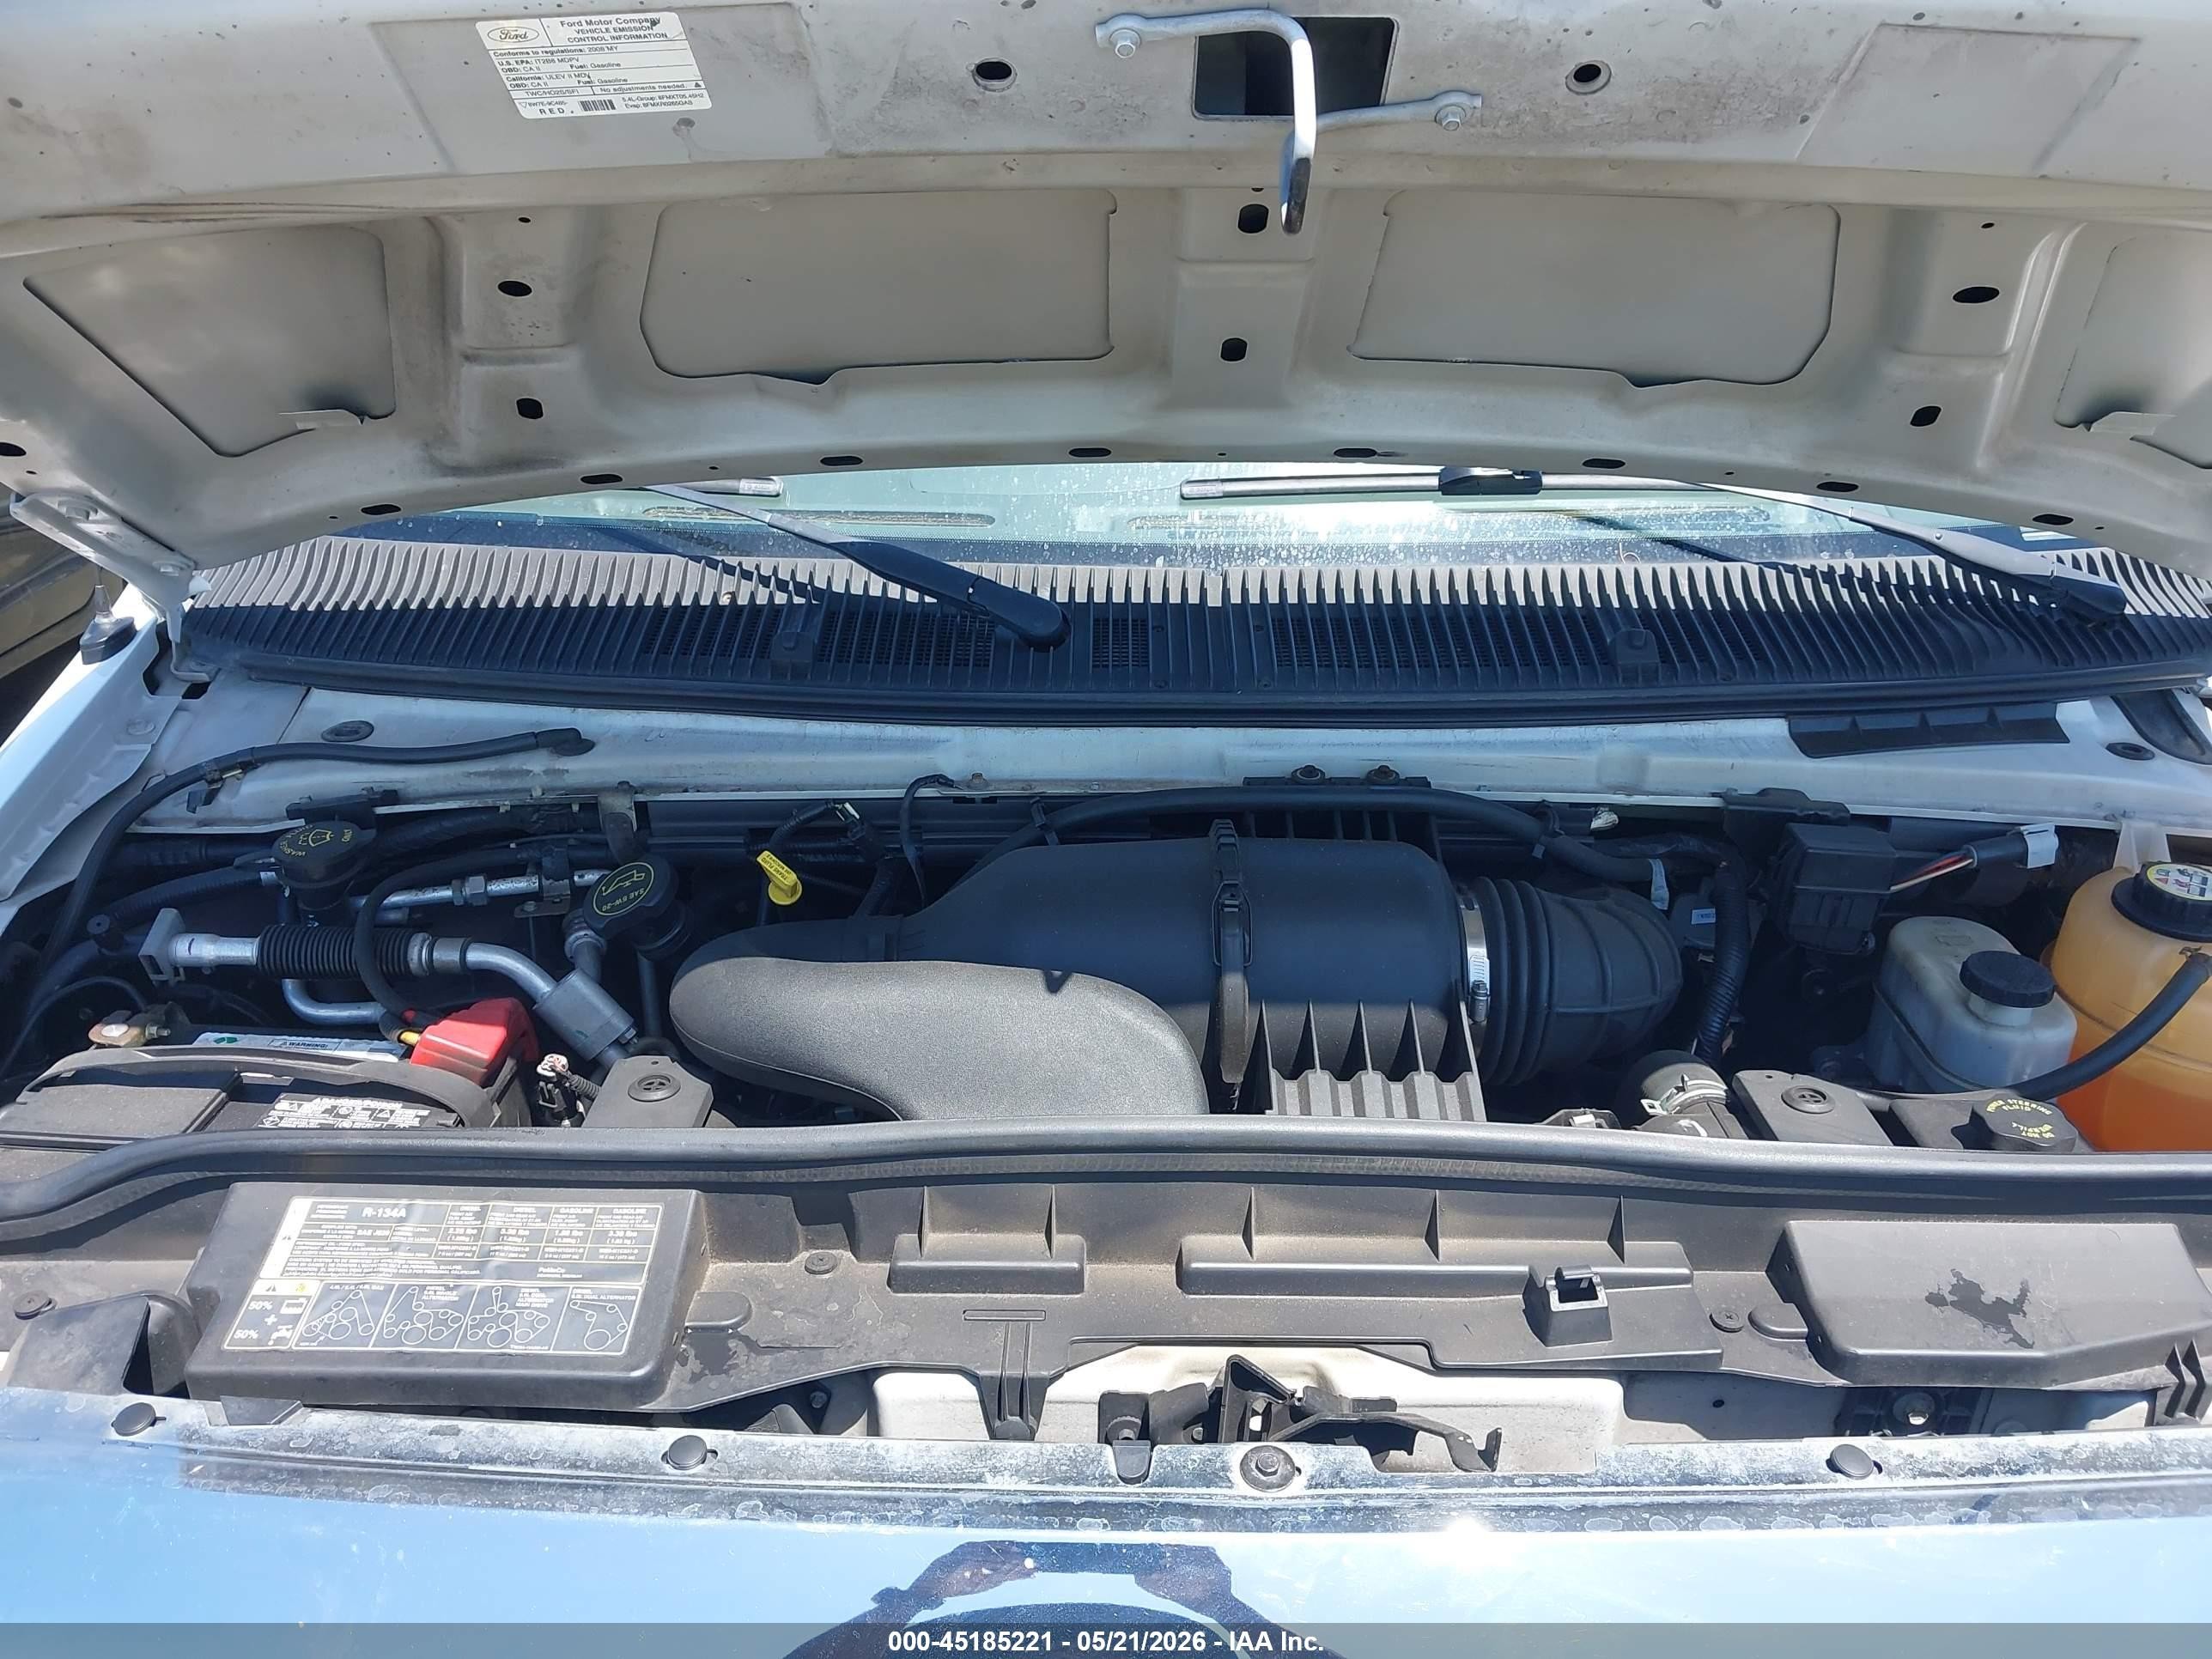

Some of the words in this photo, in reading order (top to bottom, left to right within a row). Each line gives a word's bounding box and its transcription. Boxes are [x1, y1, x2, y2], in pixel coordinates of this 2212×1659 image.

[559, 19, 583, 27] Ford
[585, 18, 613, 27] Motor
[615, 16, 660, 26] Company
[499, 28, 529, 41] Ford
[574, 27, 611, 35] VEHICLE
[612, 25, 654, 33] EMISSION
[567, 34, 609, 43] CONTROL
[610, 32, 668, 41] INFORMATION
[541, 46, 586, 56] regulations:
[613, 84, 656, 94] adjustments
[761, 857, 775, 869] FLUID
[629, 887, 645, 900] SAE
[2007, 1099, 2052, 1115] STEERING
[362, 1206, 406, 1218] R-134A
[247, 1300, 274, 1311] 50%
[234, 1329, 259, 1340] 50%
